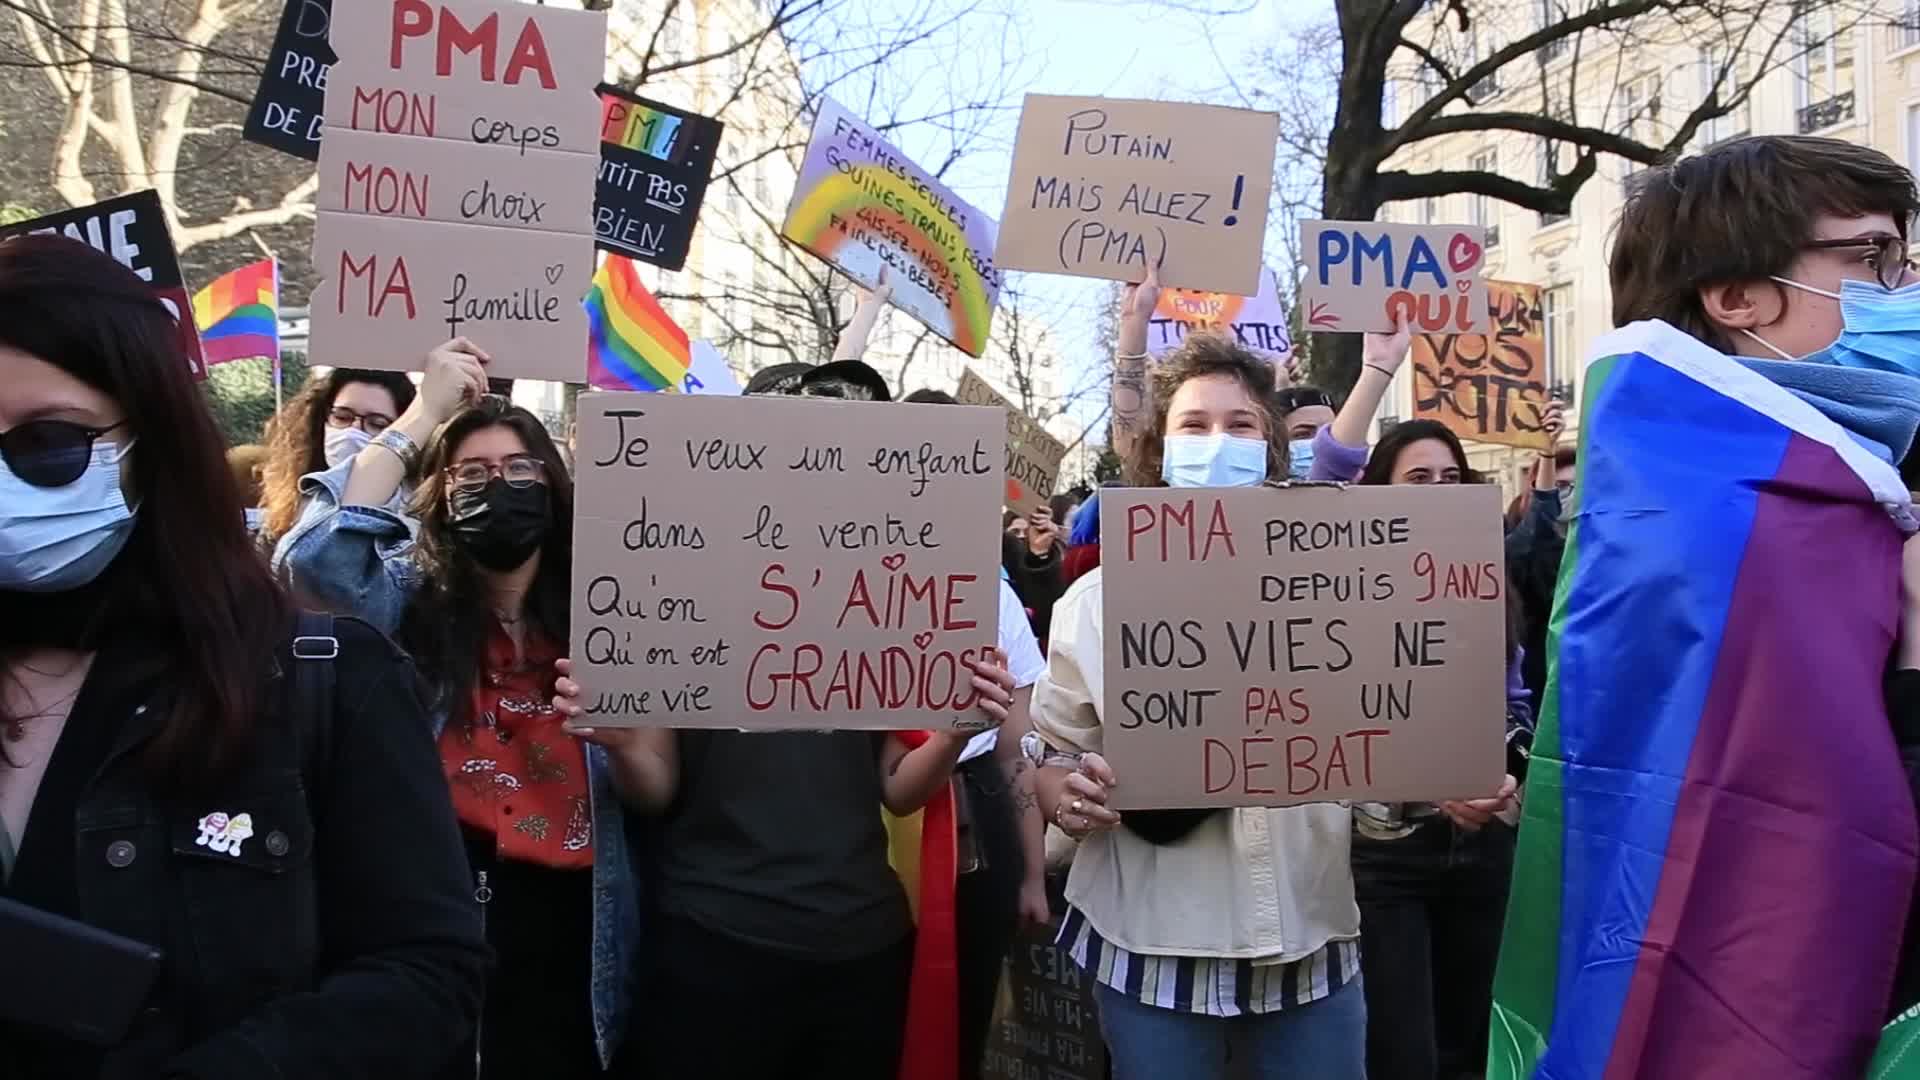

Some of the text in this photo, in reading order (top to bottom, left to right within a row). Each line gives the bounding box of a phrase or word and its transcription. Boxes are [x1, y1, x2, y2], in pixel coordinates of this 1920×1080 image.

[390, 0, 557, 90] PMA
[263, 102, 302, 136] DE
[351, 86, 560, 156] MON corps
[833, 116, 906, 181] FEMMES
[344, 161, 547, 224] MON choix
[648, 173, 688, 208] PAS
[1032, 176, 1104, 212] MAIS
[1118, 183, 1212, 225] ALLEZ
[1318, 229, 1448, 290] PMA
[338, 250, 560, 338] MA famille
[1423, 328, 1534, 377] VOS
[595, 410, 992, 498] Je veux un enfant
[623, 496, 941, 551] dans le ventre
[1127, 499, 1411, 562] PMA PROMISE
[586, 574, 707, 623] Qu'on
[1413, 551, 1438, 602] 9
[1443, 562, 1501, 601] ANS
[690, 638, 730, 667] est
[745, 631, 997, 713] GRANDIOS
[1120, 617, 1448, 673] NOS VIES NE
[585, 682, 712, 715] une vie
[1119, 679, 1414, 730] SONT PAS UN
[1203, 728, 1392, 796] DÉBAT
